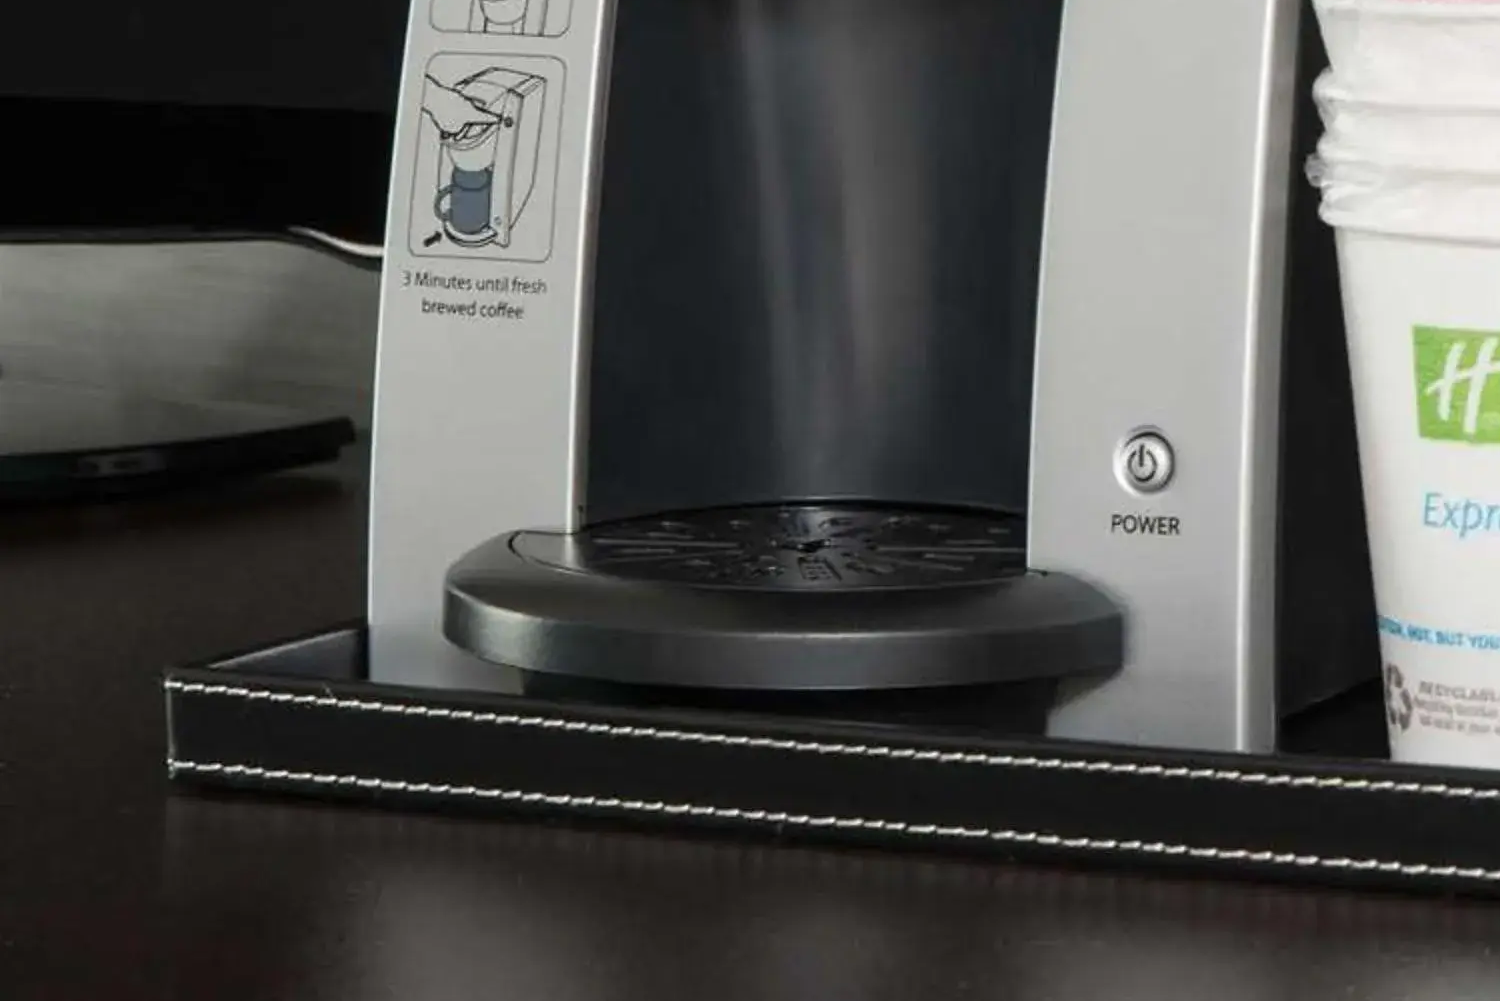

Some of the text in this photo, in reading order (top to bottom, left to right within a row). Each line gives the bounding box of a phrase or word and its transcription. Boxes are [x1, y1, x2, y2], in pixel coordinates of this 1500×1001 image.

[402, 269, 548, 295] 3 Minutes until fresh
[421, 297, 526, 320] brewed coffee
[1110, 512, 1181, 536] POWER
